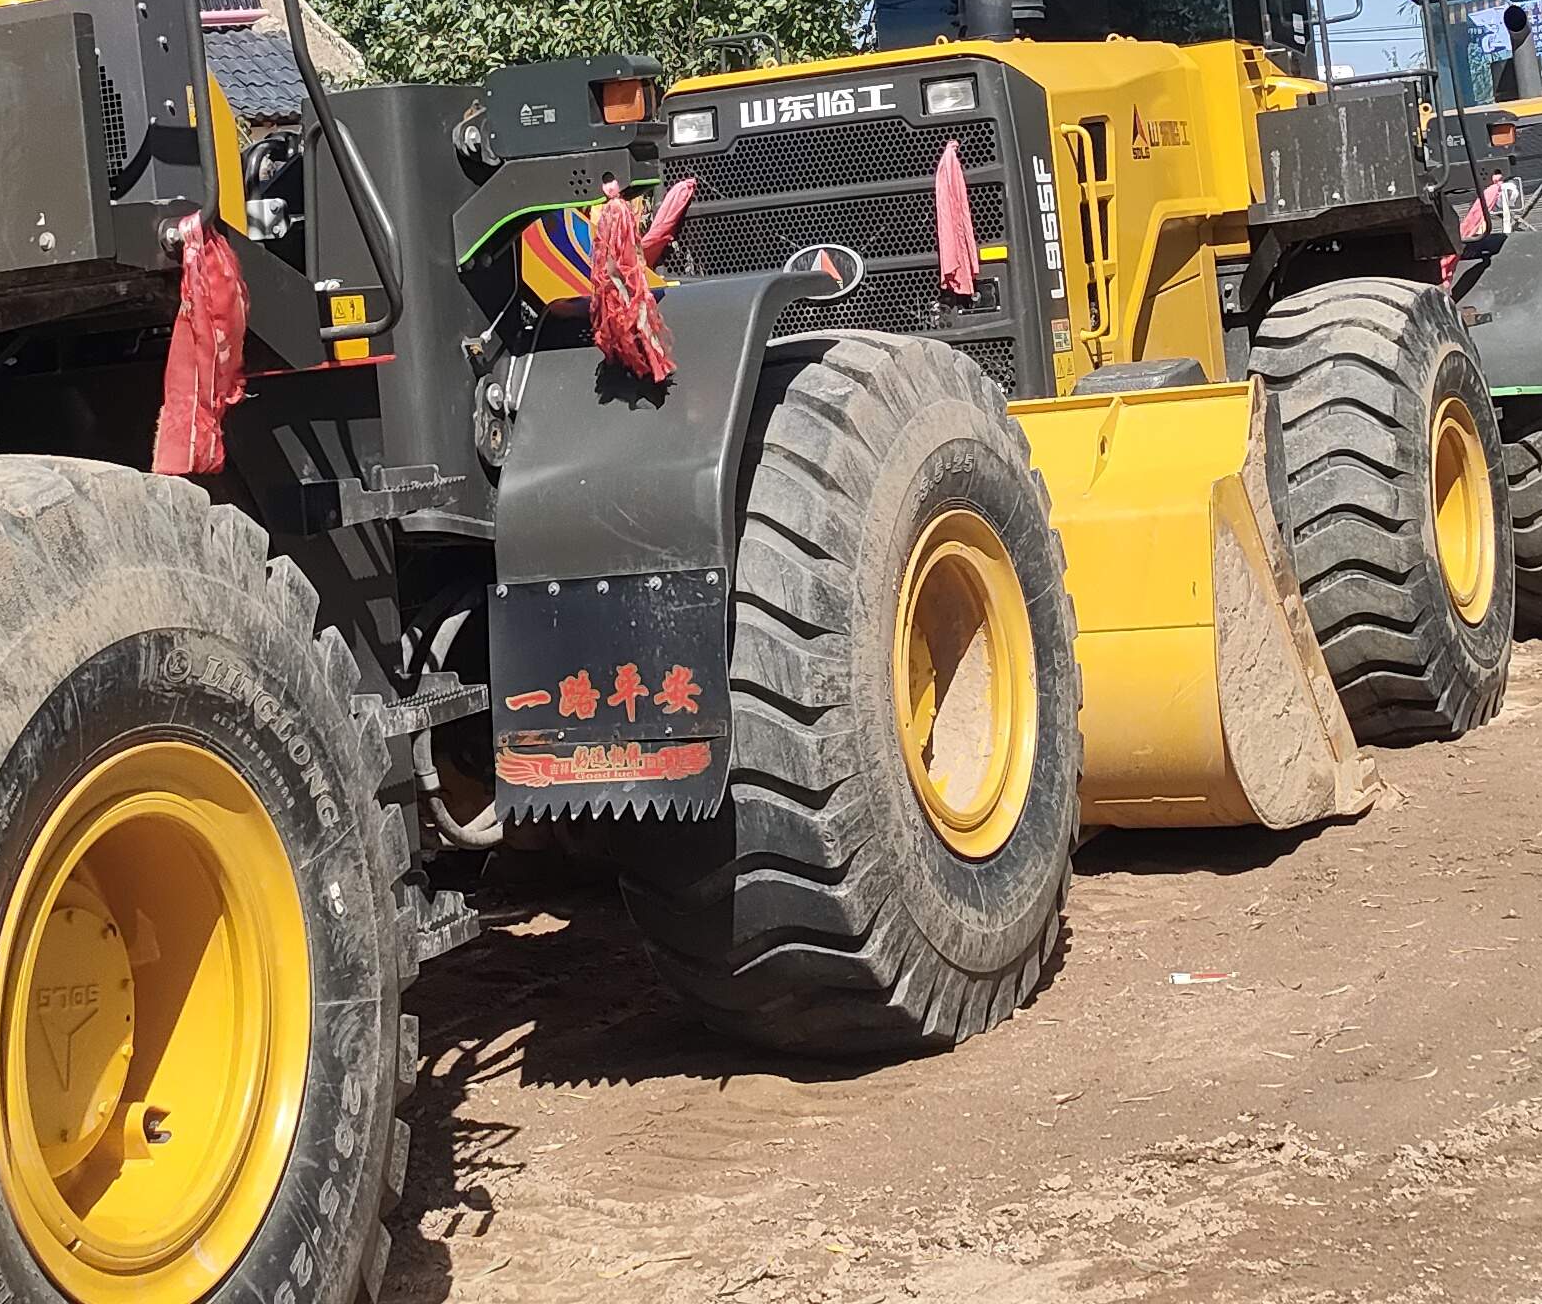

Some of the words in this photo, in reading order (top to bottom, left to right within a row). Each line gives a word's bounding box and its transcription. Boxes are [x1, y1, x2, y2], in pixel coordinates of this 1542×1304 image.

[740, 83, 897, 129] 山东临工
[1033, 155, 1065, 299] L955F
[199, 656, 341, 828] LINGLONG
[505, 662, 704, 723] 一路平安
